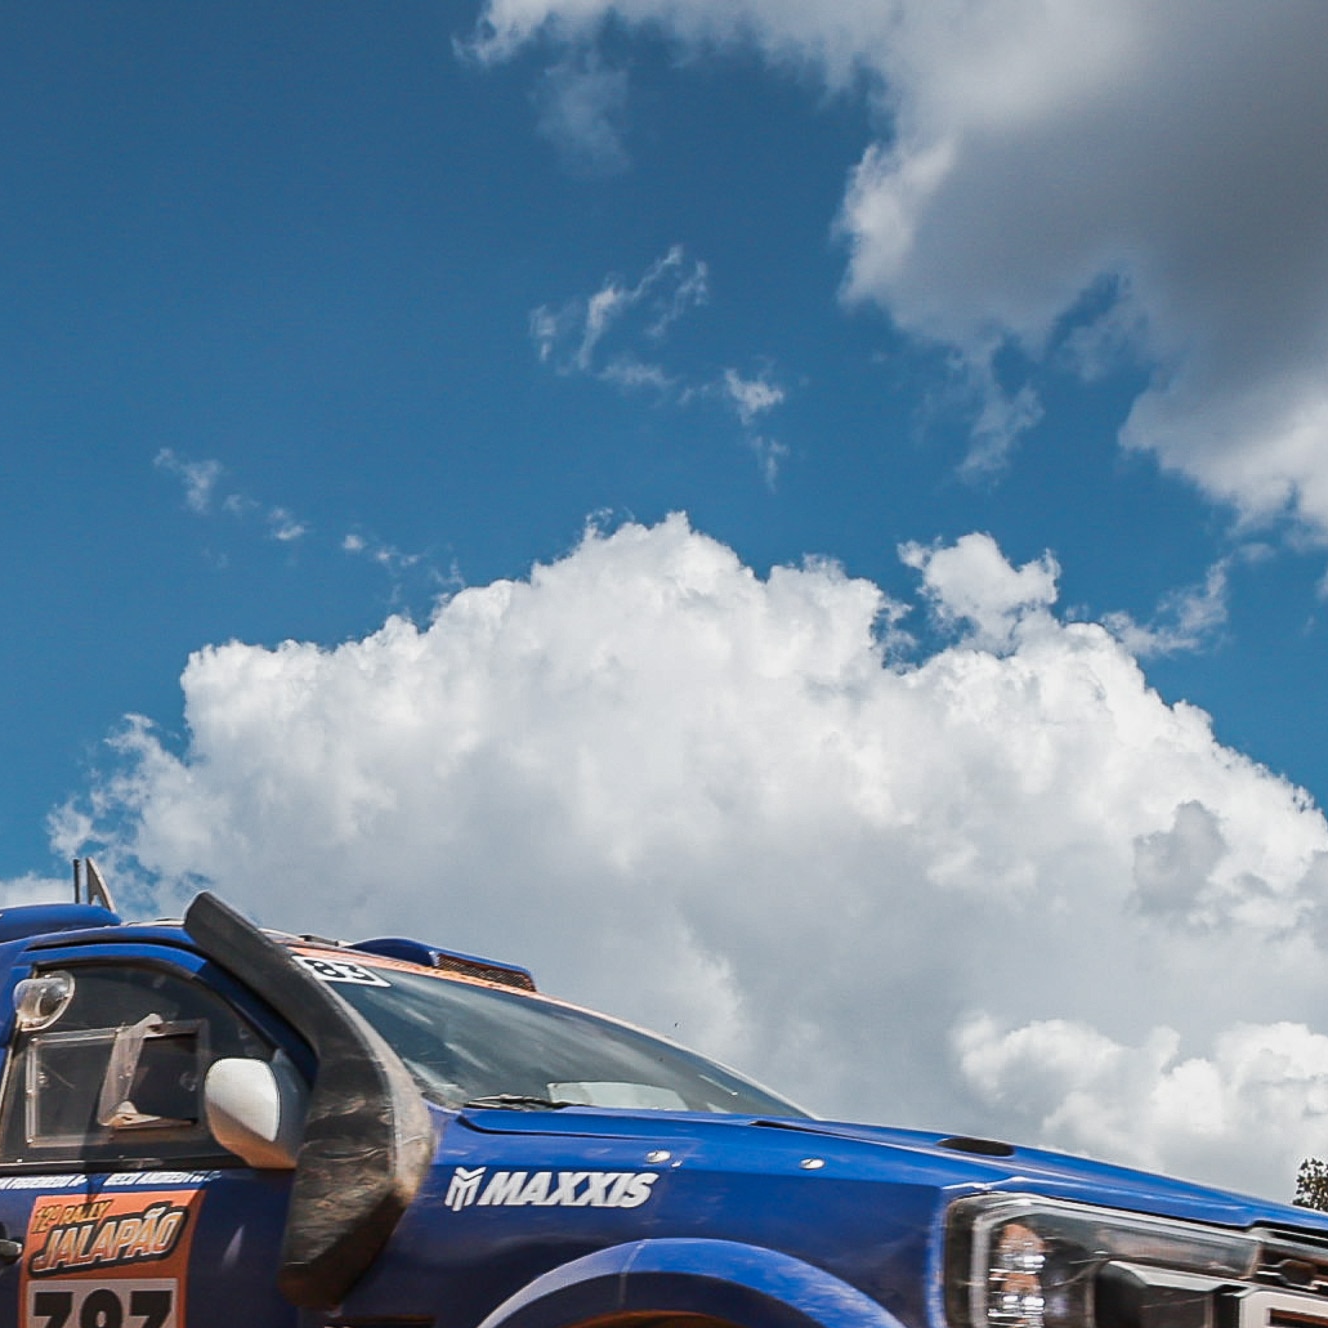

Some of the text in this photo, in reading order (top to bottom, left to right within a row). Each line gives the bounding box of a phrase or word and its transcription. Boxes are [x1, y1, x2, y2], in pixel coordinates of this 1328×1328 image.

[476, 1171, 660, 1208] MAXXIS
[58, 1198, 113, 1225] RALLY
[31, 1205, 184, 1273] JALAPÃO
